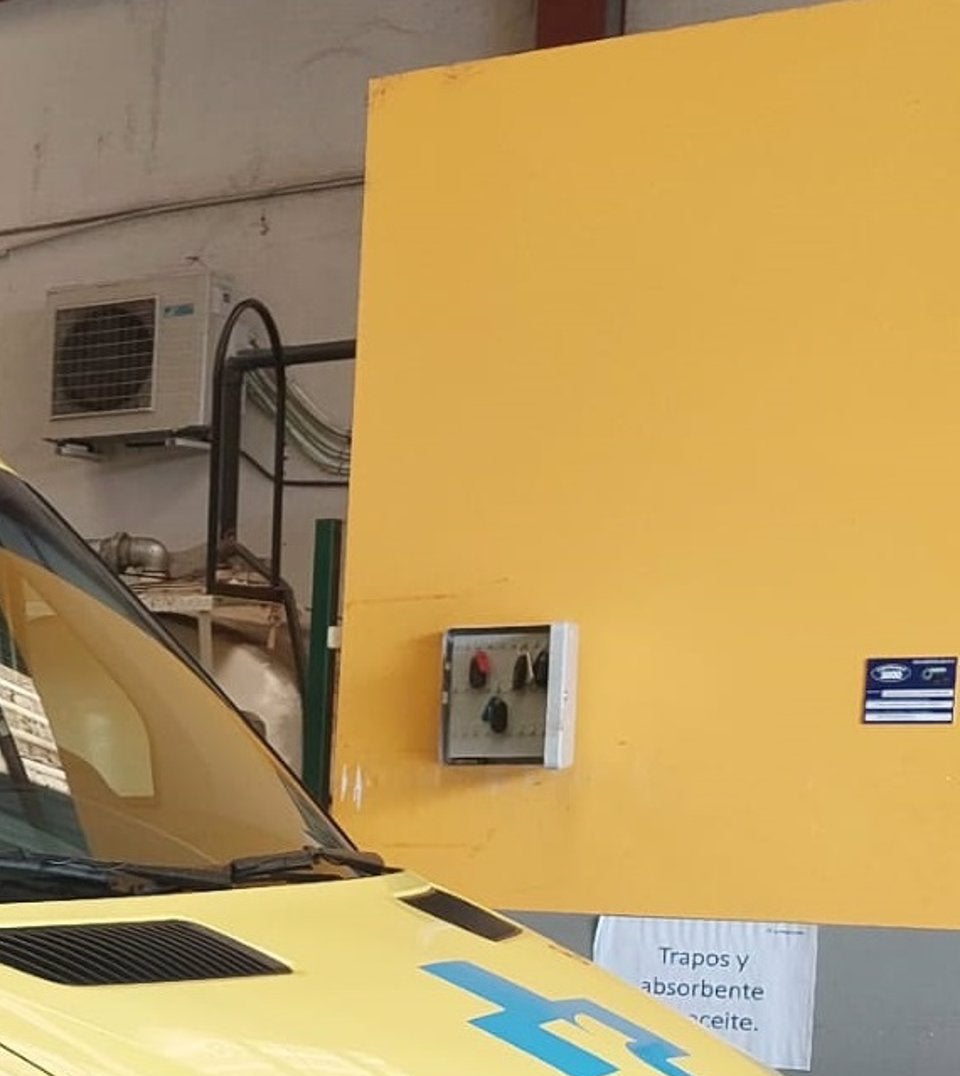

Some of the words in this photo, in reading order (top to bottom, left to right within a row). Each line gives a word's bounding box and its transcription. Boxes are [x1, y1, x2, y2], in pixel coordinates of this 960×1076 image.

[658, 946, 730, 970] Trapos
[736, 953, 750, 973] y
[641, 975, 765, 1001] absorbente
